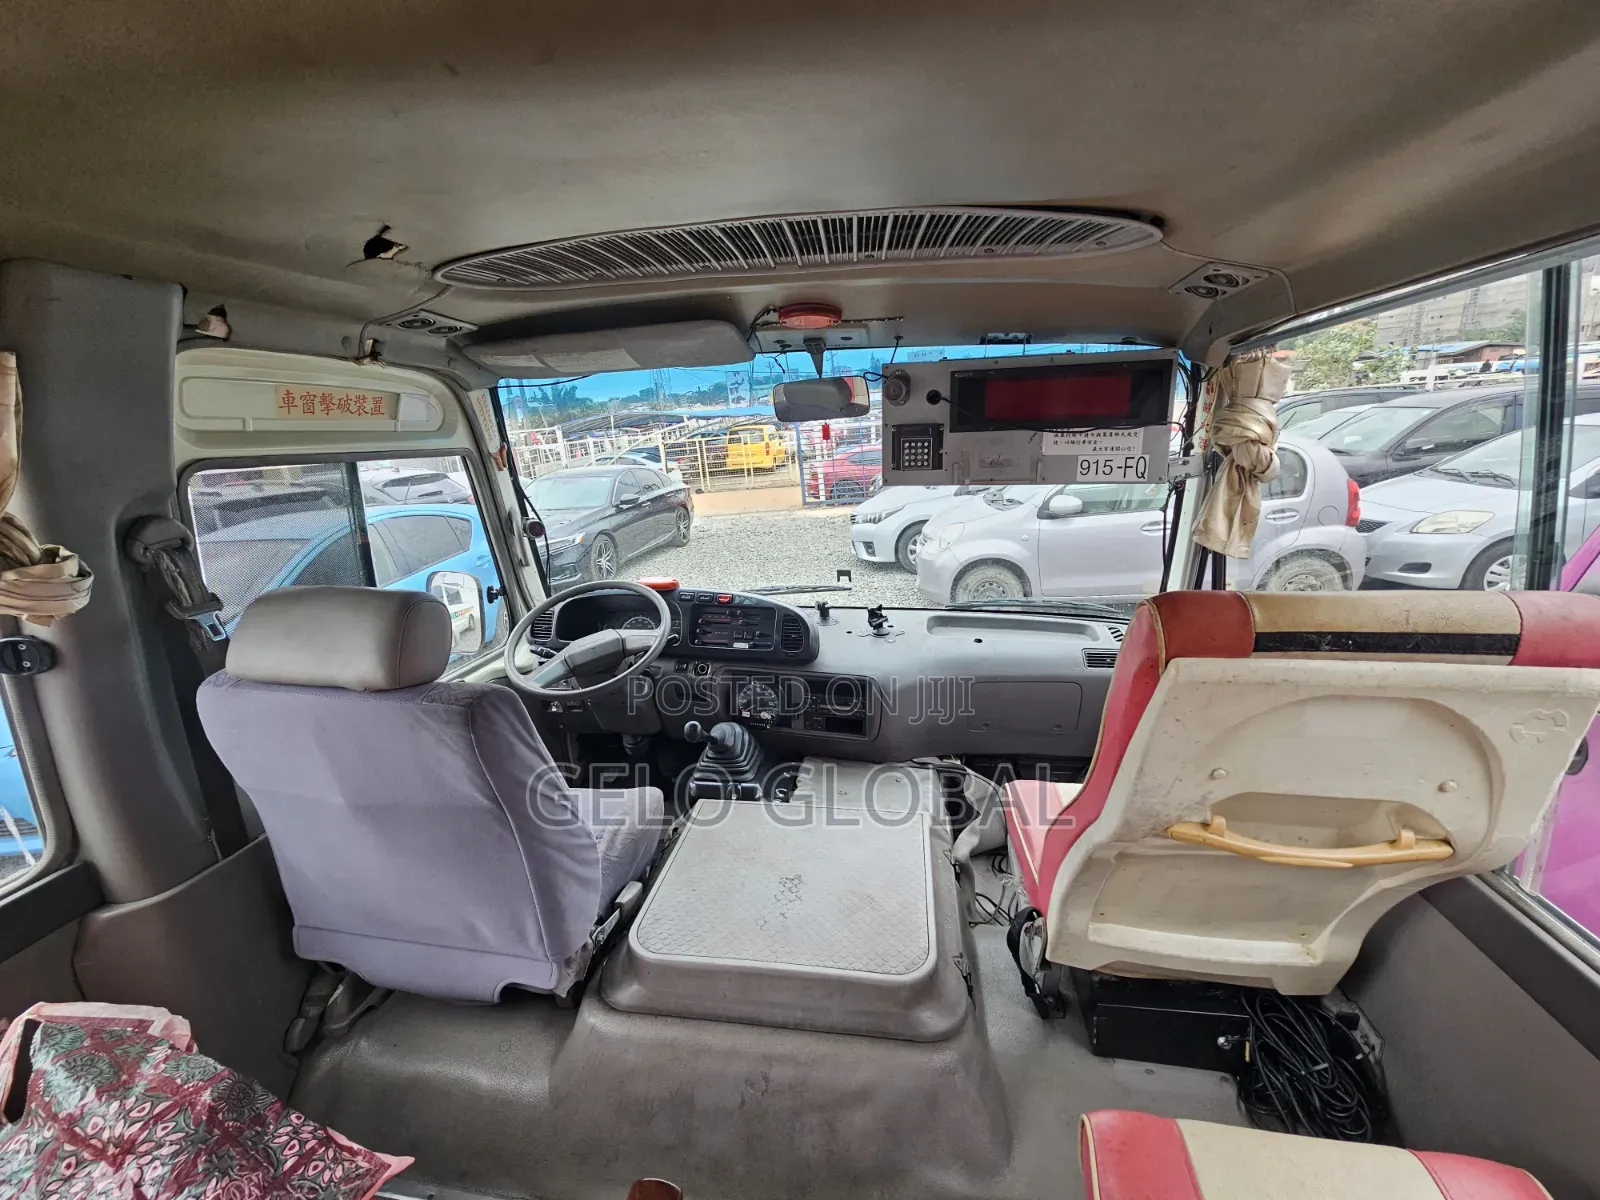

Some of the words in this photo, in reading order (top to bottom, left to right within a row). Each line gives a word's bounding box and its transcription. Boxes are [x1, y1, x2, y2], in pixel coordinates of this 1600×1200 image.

[278, 389, 385, 416] 車窗擊破裝置
[1080, 456, 1147, 479] 915-FQ
